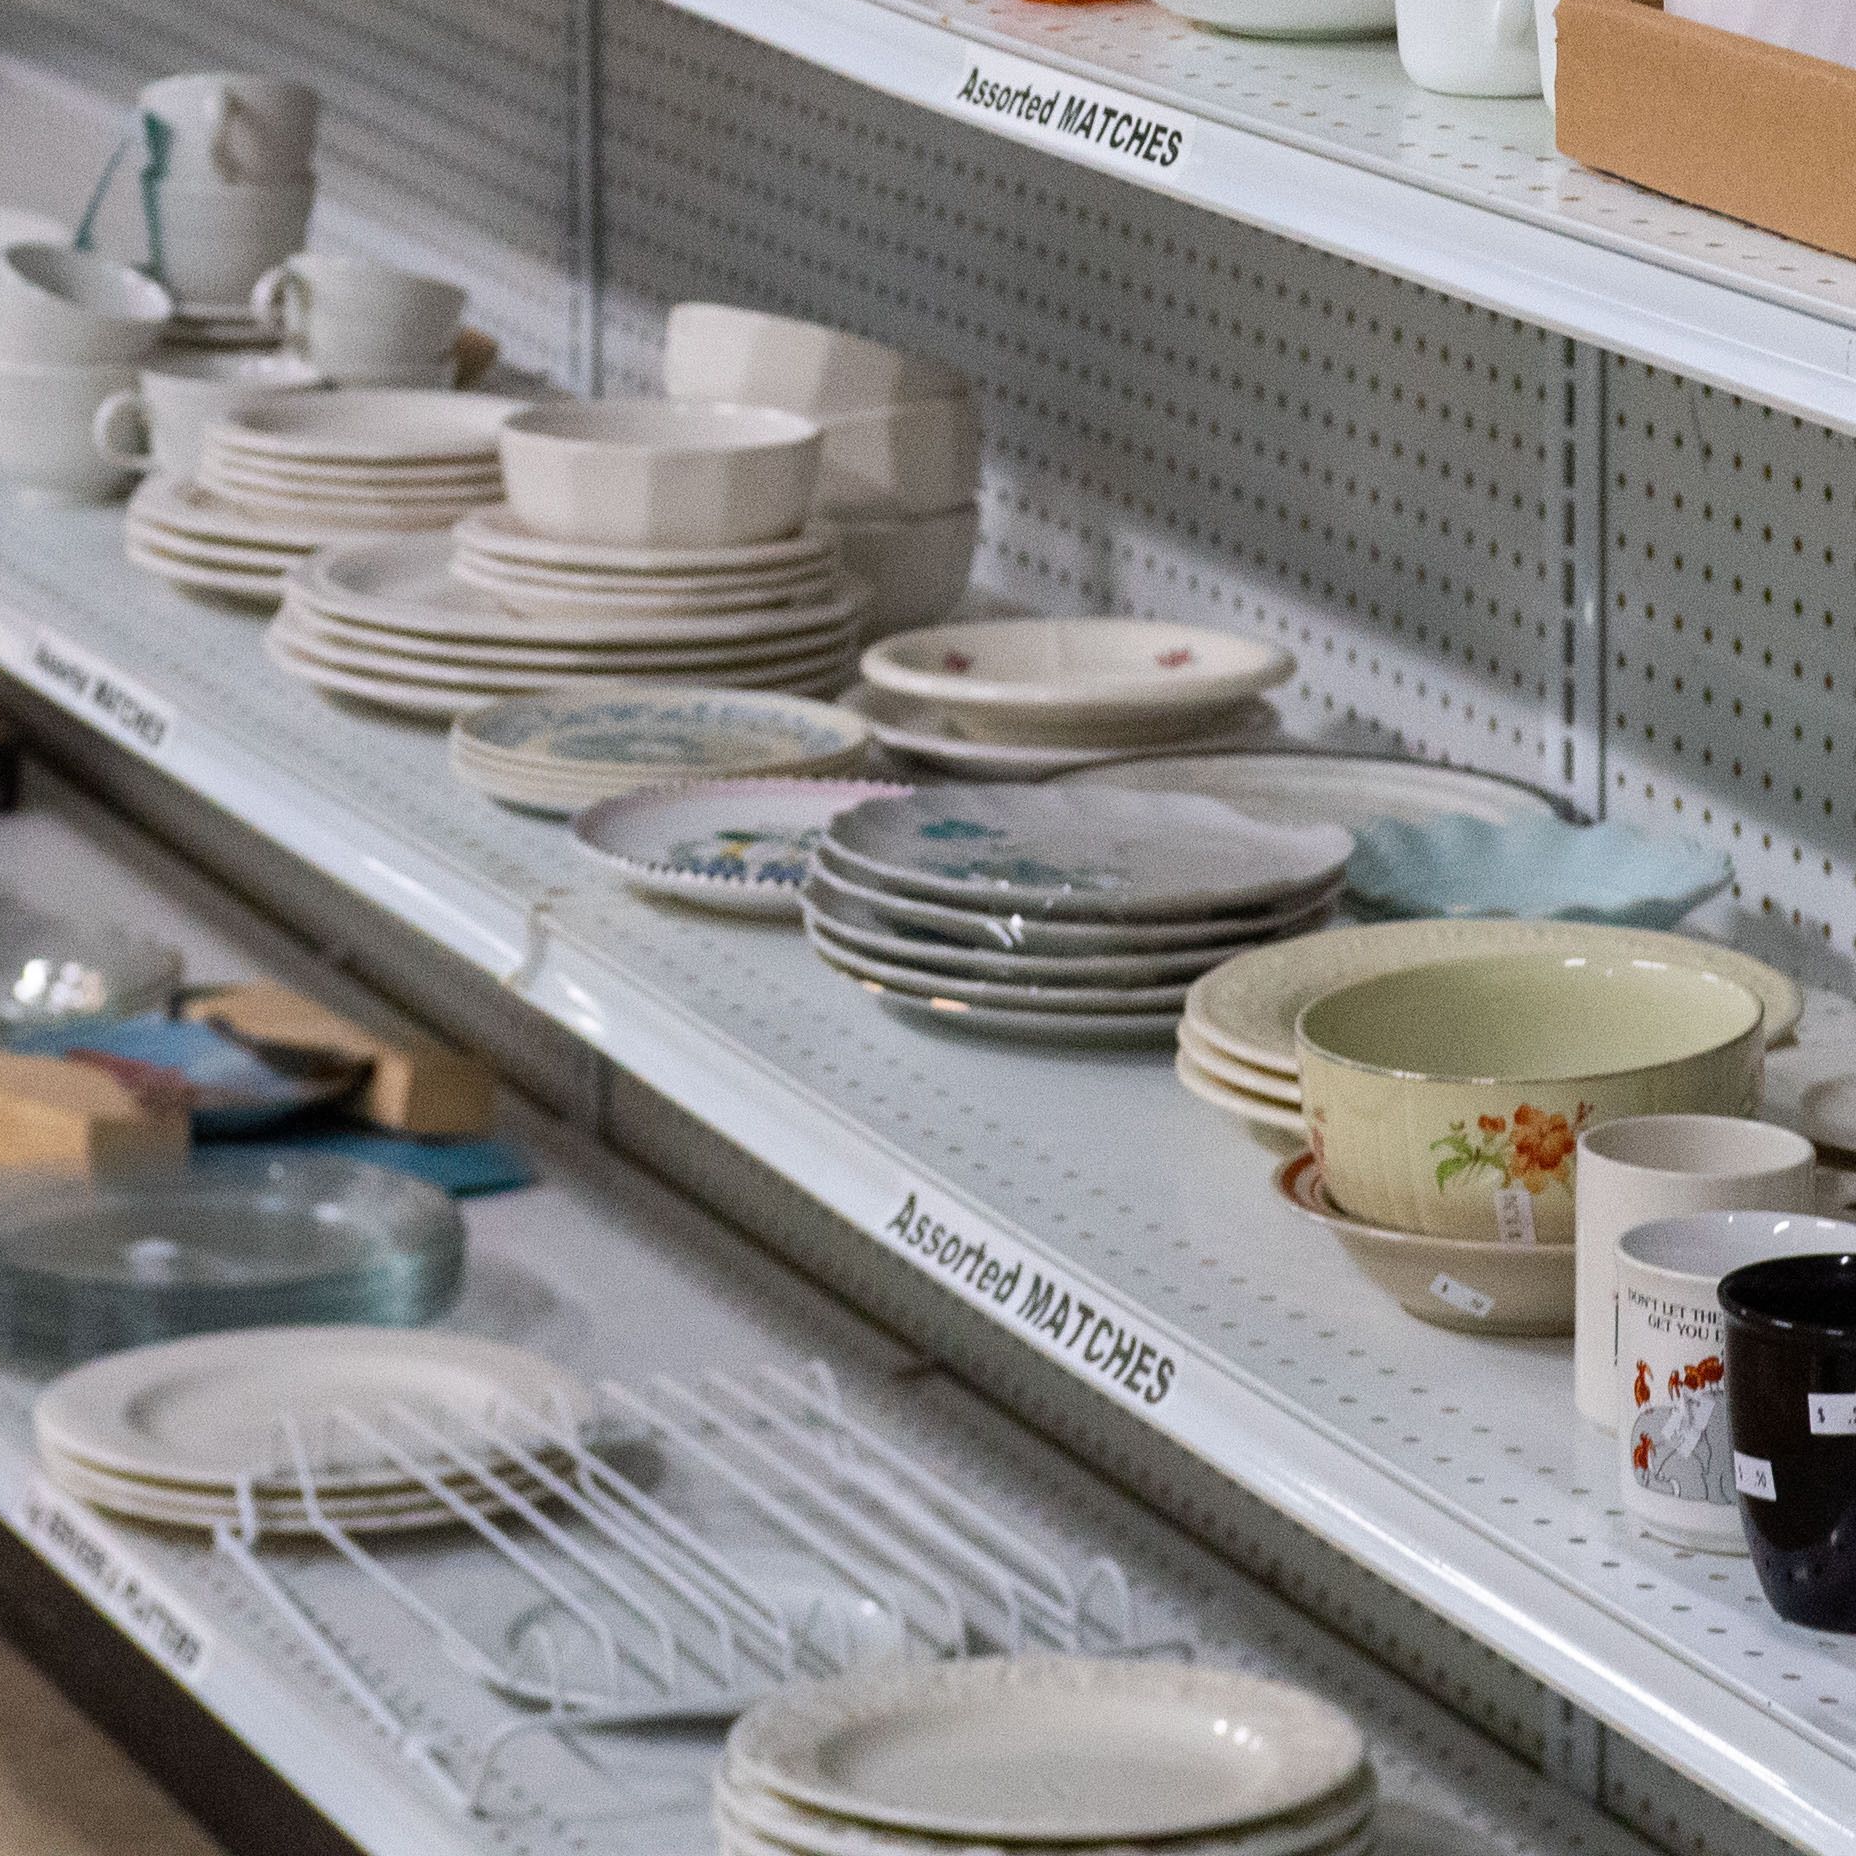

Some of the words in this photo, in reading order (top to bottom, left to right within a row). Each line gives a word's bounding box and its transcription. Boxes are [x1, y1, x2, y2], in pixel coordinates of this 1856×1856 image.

[956, 66, 1061, 125] Assorted
[1057, 94, 1183, 167] MATCHES
[886, 1191, 1022, 1305] Assorted
[1015, 1273, 1176, 1404] MATCHES
[1648, 1313, 1671, 1333] GET
[1677, 1322, 1710, 1341] YOU
[1662, 1300, 1686, 1319] LET
